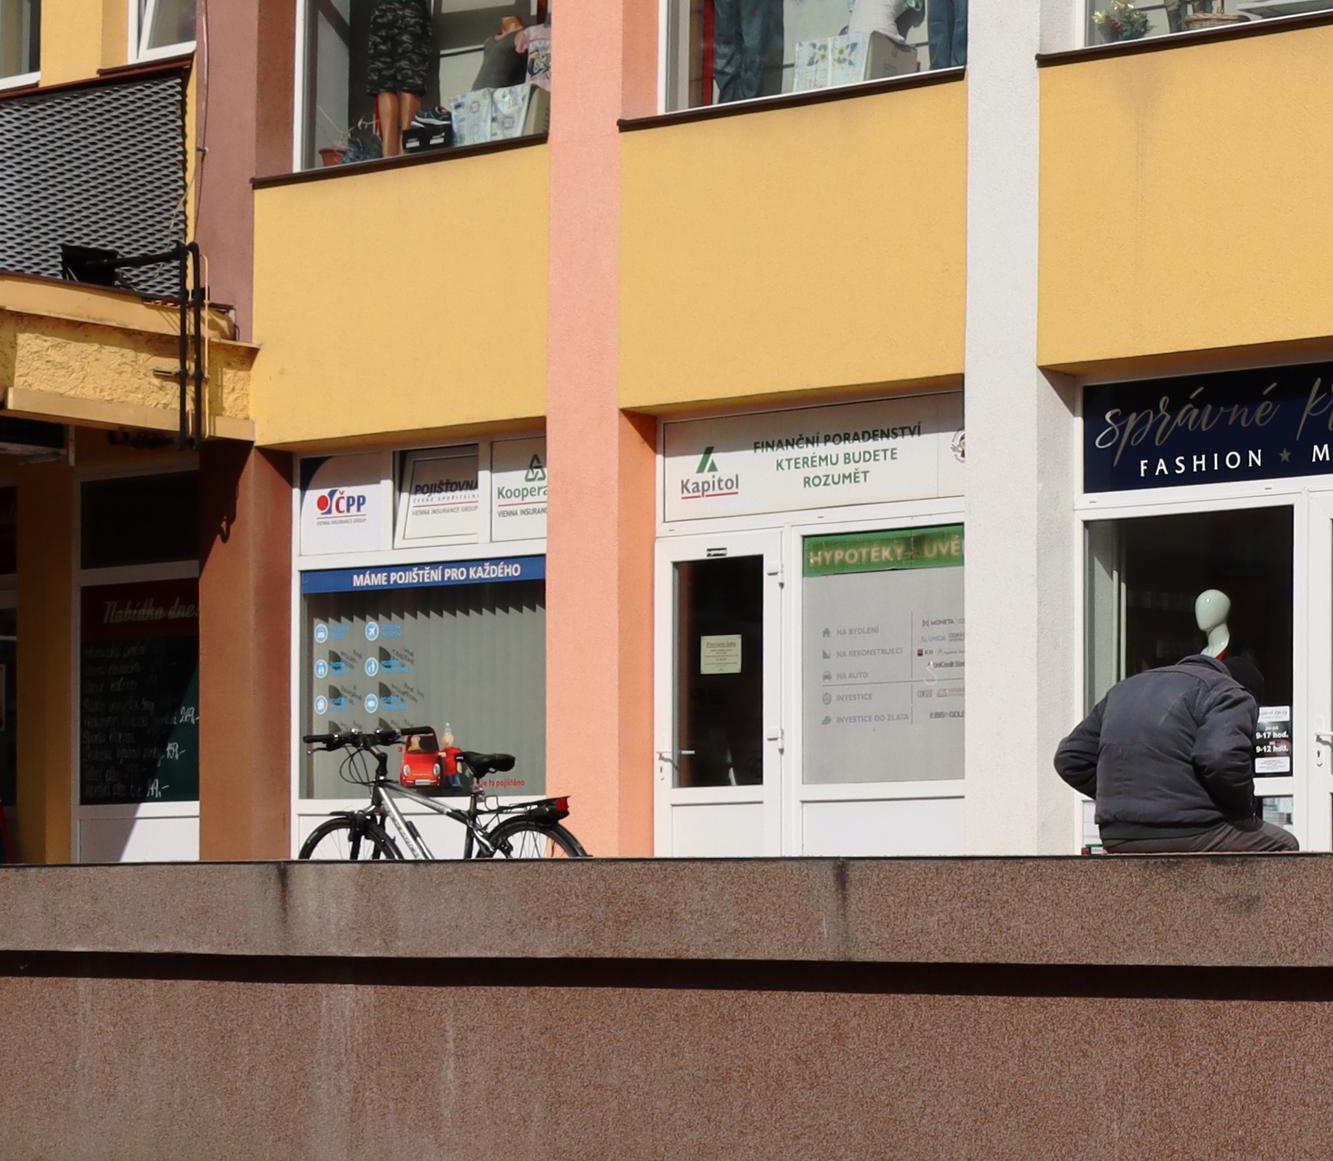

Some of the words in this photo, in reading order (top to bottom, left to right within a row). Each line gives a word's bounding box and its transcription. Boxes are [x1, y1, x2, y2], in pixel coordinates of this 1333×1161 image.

[1095, 383, 1281, 467] správné
[753, 435, 820, 454] FINANČNÍ
[824, 422, 921, 445] PORADENSTVÍ
[776, 454, 839, 471] KTERÉMU
[844, 448, 898, 465] BUDETE
[1140, 449, 1263, 477] FASHION
[680, 473, 739, 497] Kapitol
[803, 469, 870, 489] ROZUMĚT
[335, 490, 367, 514] ČPP
[353, 571, 387, 587] MÁME
[390, 566, 443, 584] POJIŠTĚNÍ
[445, 568, 467, 581] PRO
[469, 561, 521, 580] KAŽDÉHO
[836, 693, 873, 702] INVESTICE
[836, 715, 873, 724] INVESTICE
[1255, 731, 1271, 739] 9-17
[1255, 745, 1271, 753] 9-12
